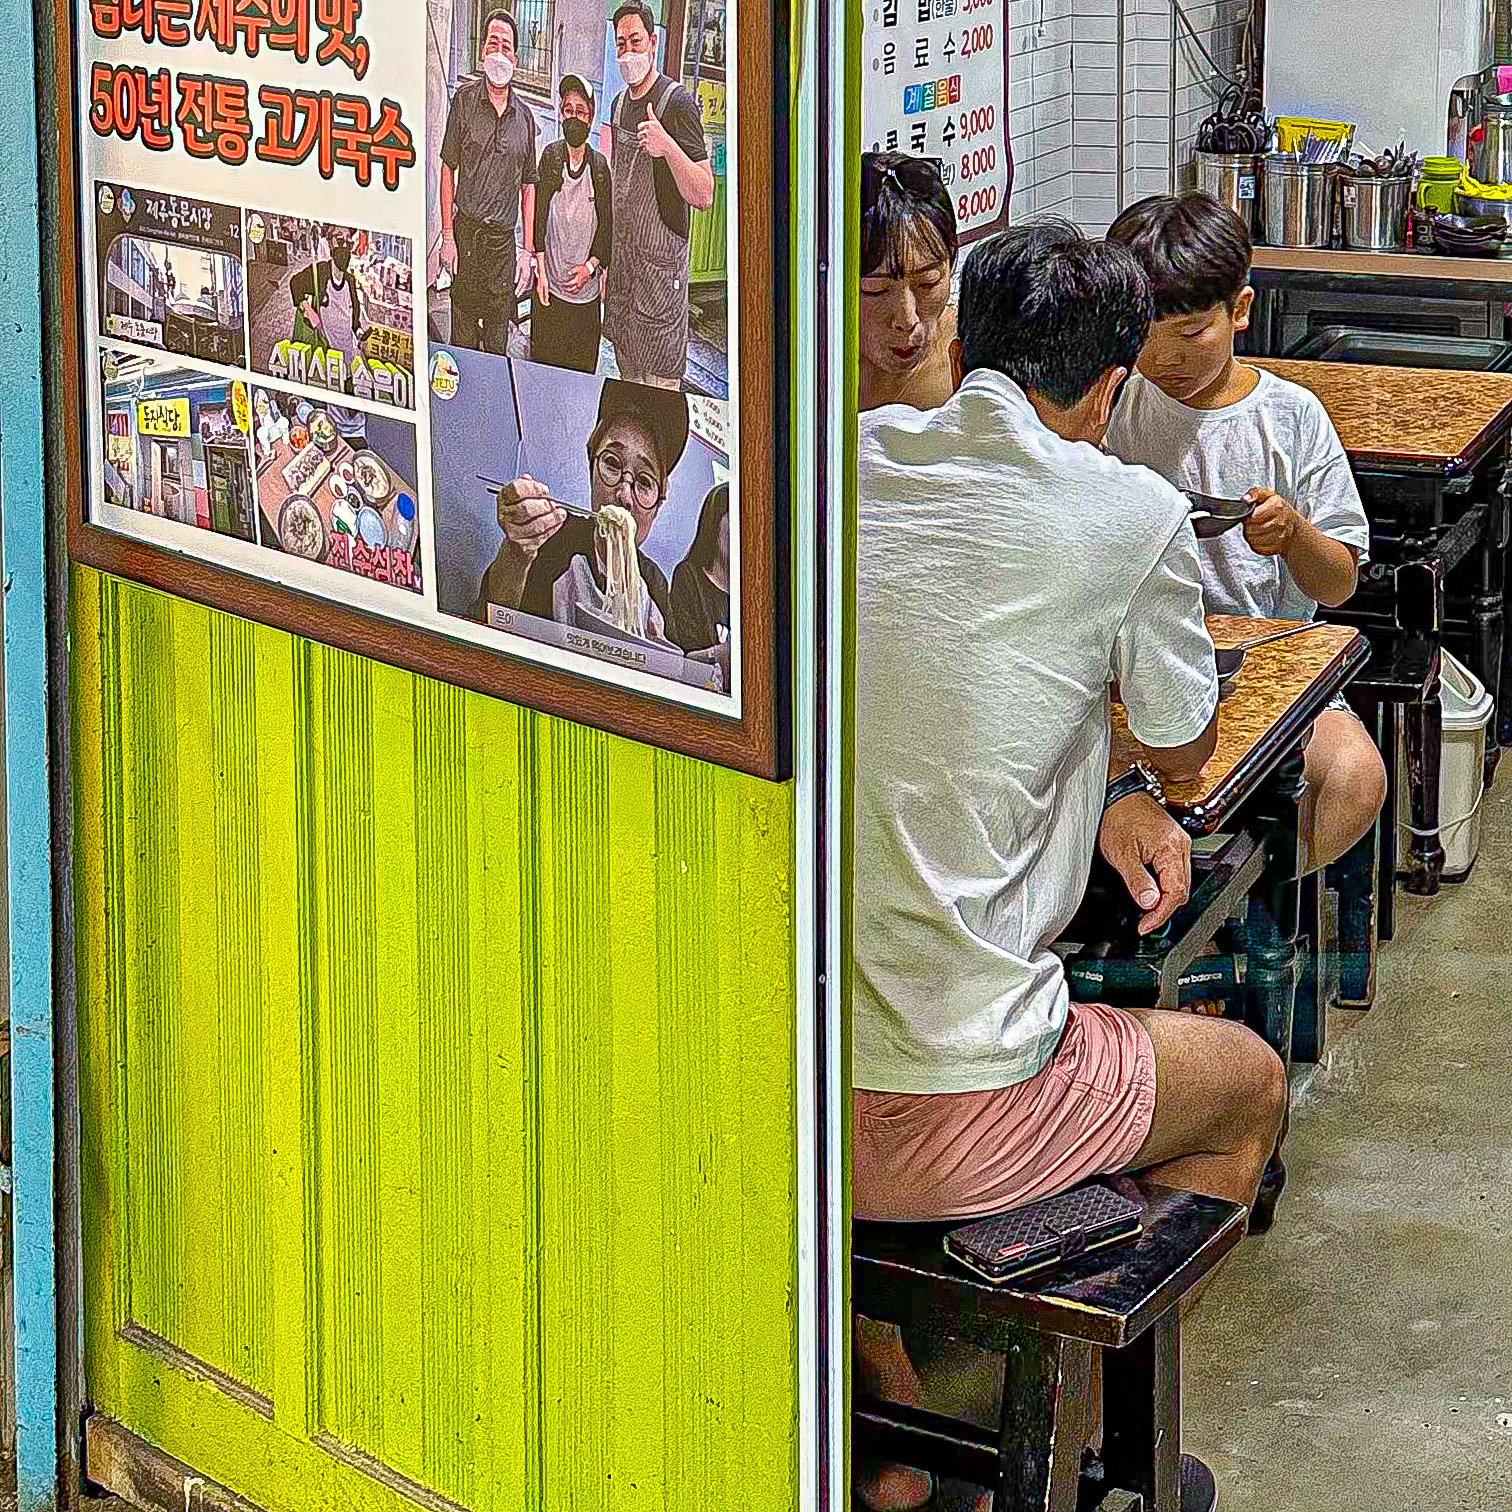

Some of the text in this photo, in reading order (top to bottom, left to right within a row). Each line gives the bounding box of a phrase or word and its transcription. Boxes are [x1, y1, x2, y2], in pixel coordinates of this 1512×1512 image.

[960, 24, 994, 59] 2,000
[904, 75, 960, 113] 계절음식
[89, 61, 416, 191] 50년 전통 고기국수
[959, 105, 995, 142] 9,000
[960, 145, 996, 183] 8,000
[957, 185, 997, 223] 8,000
